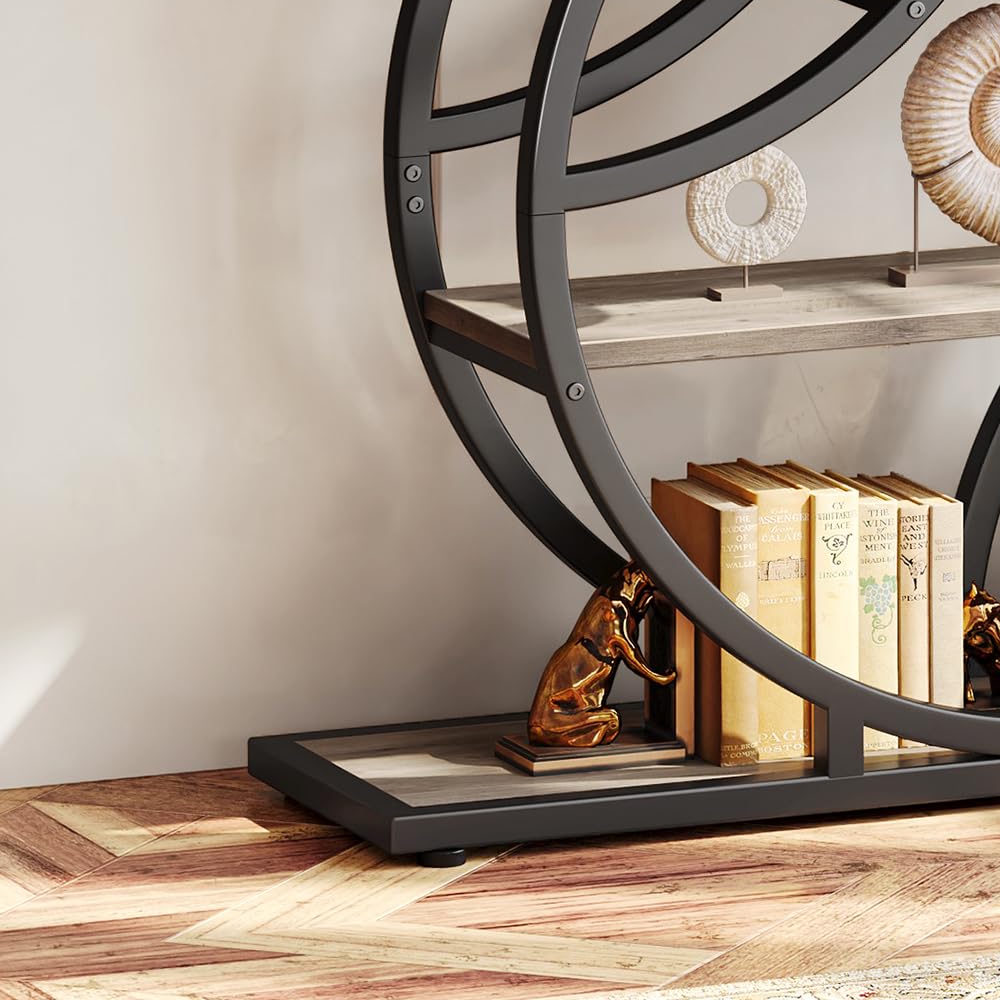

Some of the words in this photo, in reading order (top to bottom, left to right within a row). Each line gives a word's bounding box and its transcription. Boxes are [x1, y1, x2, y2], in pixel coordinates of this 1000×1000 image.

[867, 508, 889, 518] THE
[824, 521, 850, 531] PLACE
[863, 518, 894, 528] WINE
[901, 523, 928, 533] EAST
[902, 533, 926, 542] AND
[864, 543, 893, 552] MENT
[899, 541, 929, 551] WEST
[901, 594, 928, 602] PECK
